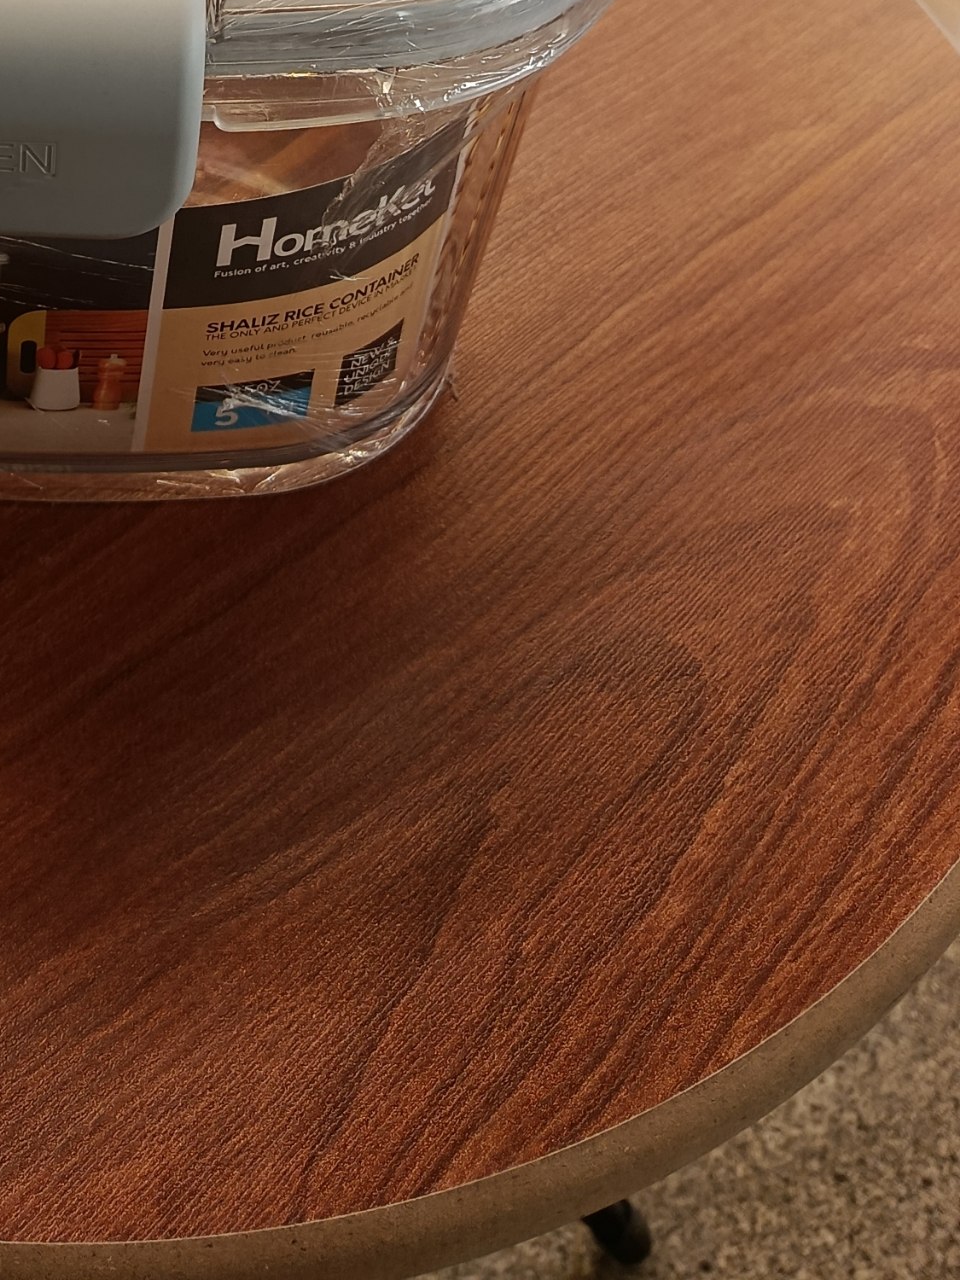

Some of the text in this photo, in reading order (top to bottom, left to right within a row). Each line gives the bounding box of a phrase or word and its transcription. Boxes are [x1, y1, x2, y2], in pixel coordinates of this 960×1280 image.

[214, 196, 433, 278] Fusion of art, creativity & industry together
[206, 253, 420, 334] SHALIZ RICE CONTAINER
[205, 332, 227, 342] THE
[229, 327, 260, 338] ONLY
[263, 322, 287, 334] AND
[291, 309, 337, 328] PERFECT
[339, 295, 373, 316] DEVICE
[373, 290, 384, 299] IN
[201, 357, 225, 367] very
[228, 355, 252, 366] easy
[255, 352, 266, 360] to
[203, 348, 228, 358] Very
[231, 342, 265, 354] useful
[350, 343, 386, 369] NEW
[344, 360, 390, 395] DESIGN
[214, 398, 238, 426] 5
